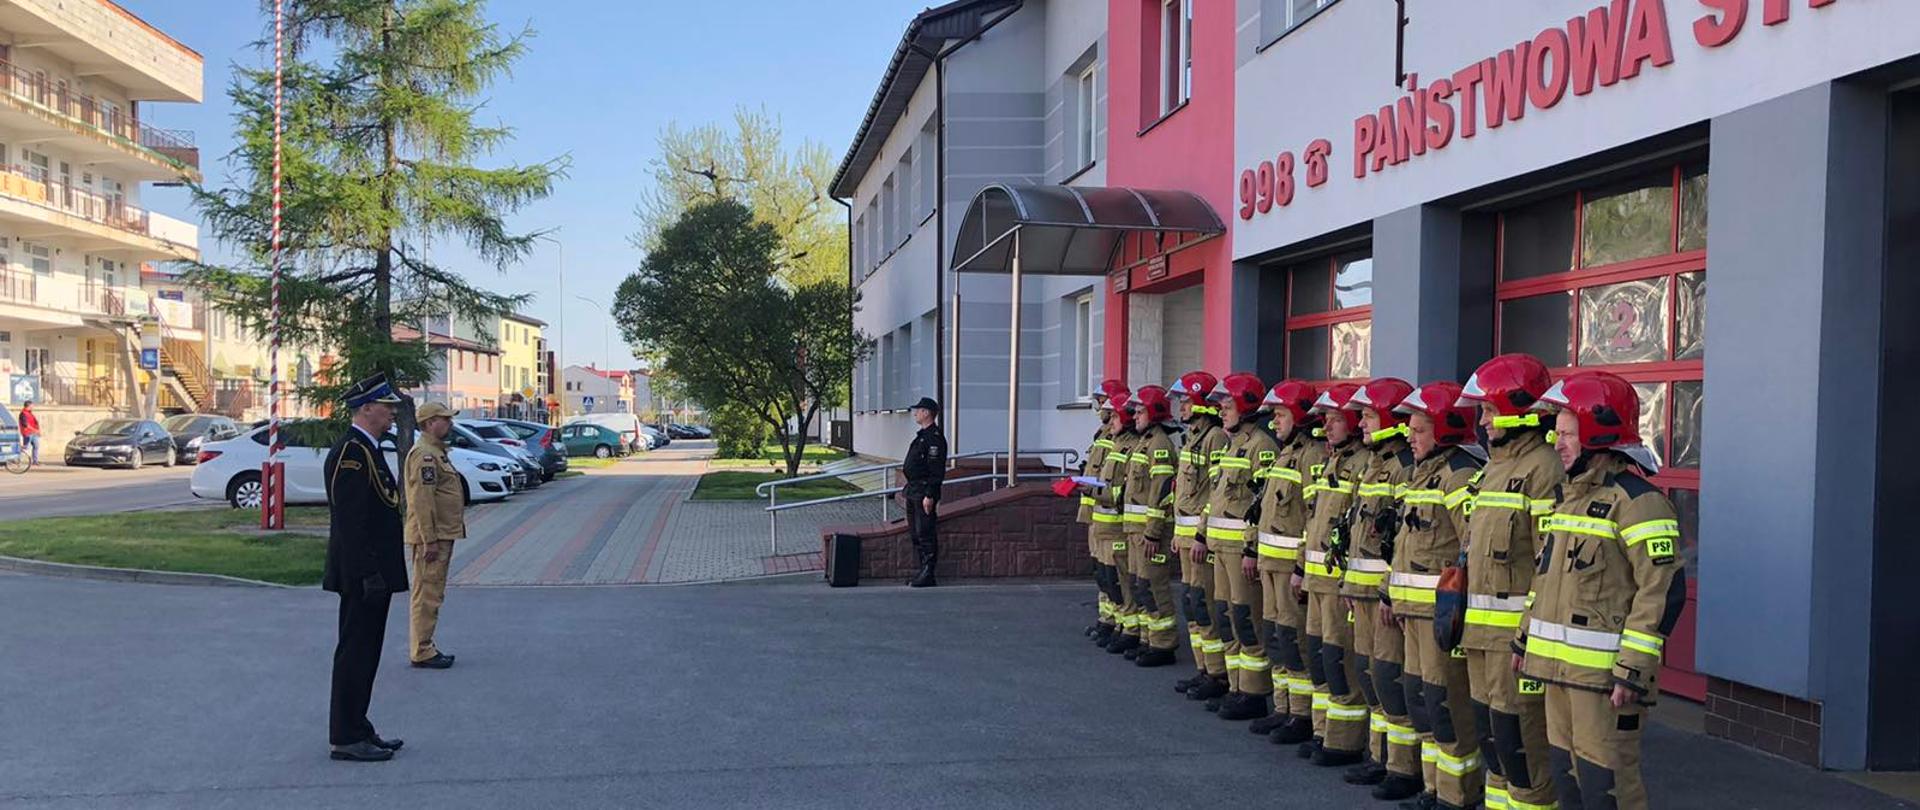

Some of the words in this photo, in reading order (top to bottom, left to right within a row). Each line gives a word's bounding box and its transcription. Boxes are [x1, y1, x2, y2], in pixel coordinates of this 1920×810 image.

[1240, 151, 1294, 220] 998
[1354, 0, 1674, 179] PAŃSTWOWA
[1611, 301, 1634, 348] 2
[1652, 541, 1671, 553] PSP
[1522, 681, 1543, 692] PSP
